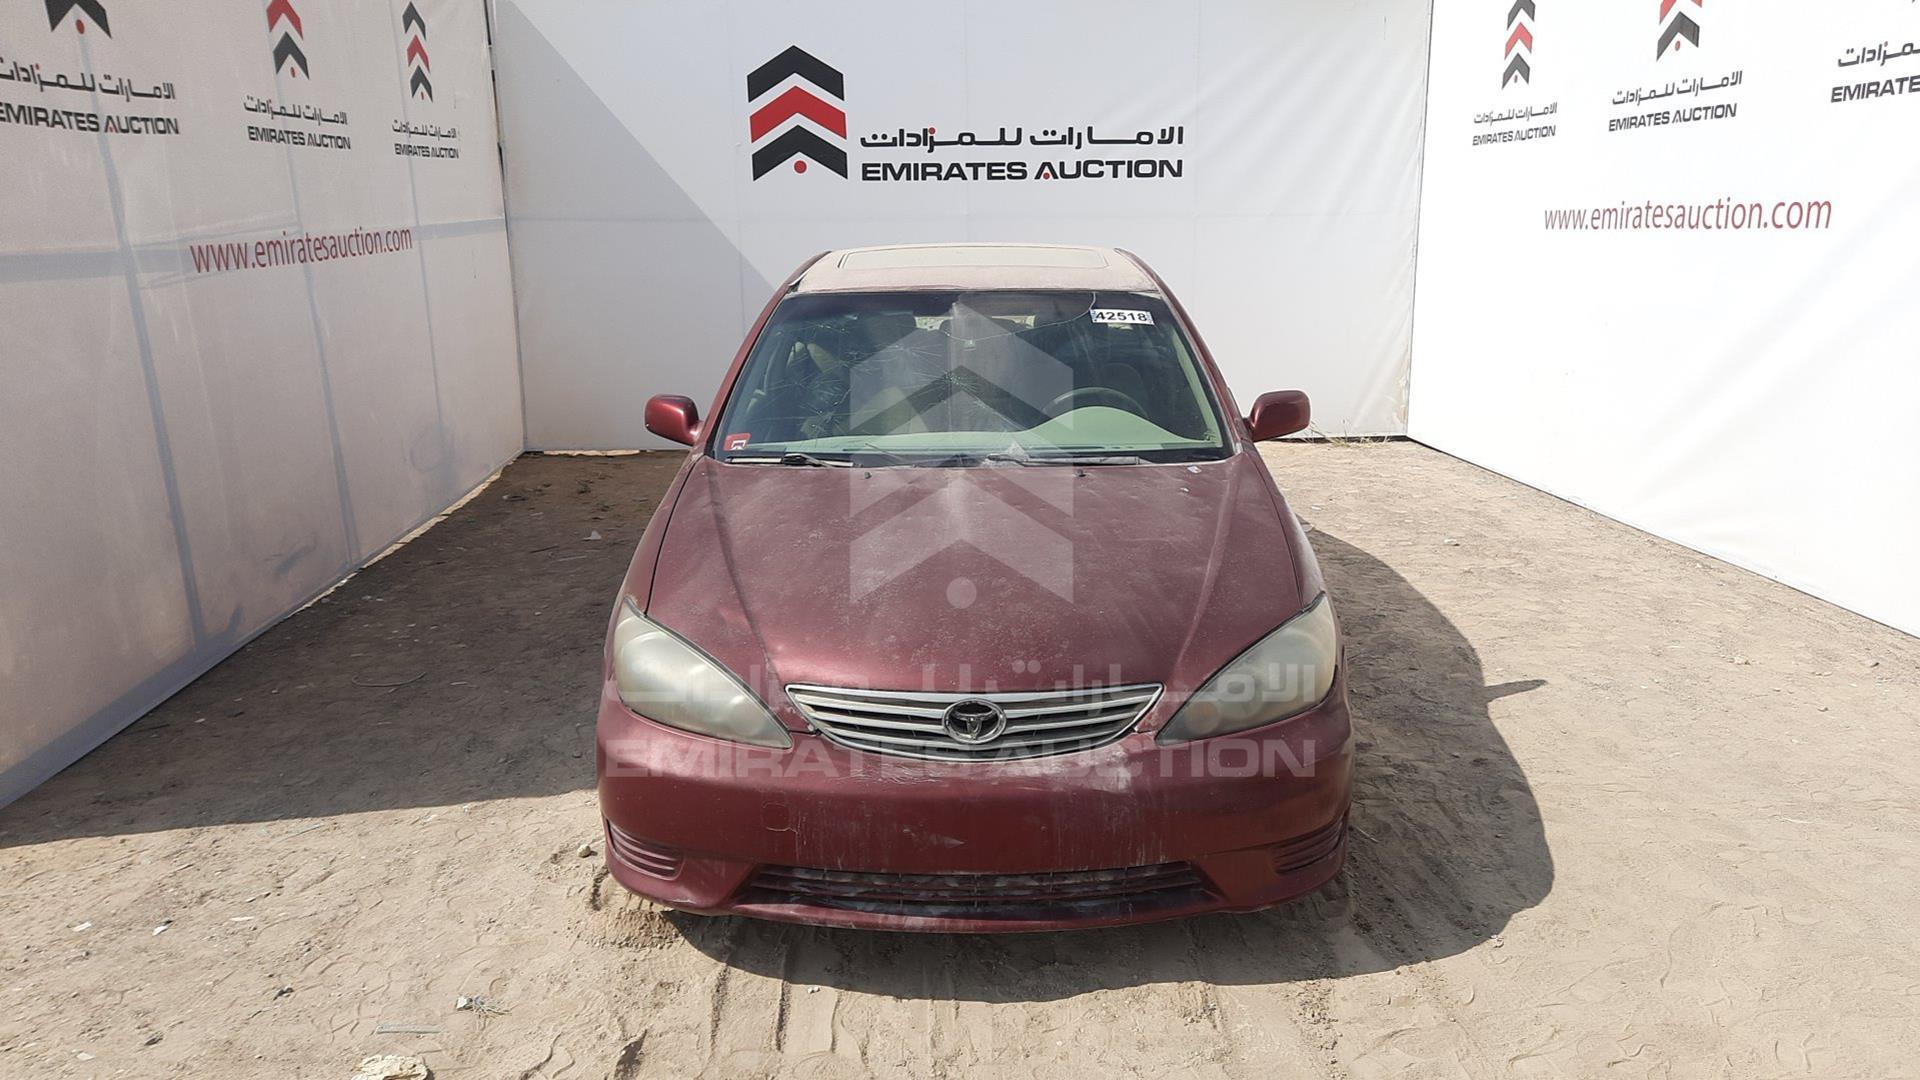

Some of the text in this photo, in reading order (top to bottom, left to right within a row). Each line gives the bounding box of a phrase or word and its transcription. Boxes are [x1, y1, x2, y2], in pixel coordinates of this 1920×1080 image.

[1838, 41, 1920, 67] مزادات
[99, 74, 176, 102] الامارات
[1612, 70, 1743, 106] الامارات للمزادات
[1830, 74, 1920, 103] EMIRATE
[243, 94, 348, 126] الامارات للمزادات
[1608, 102, 1738, 132] EMIRATES AUCTION
[104, 115, 180, 134] AUCTION
[247, 126, 351, 149] EMIRATES AUCTION
[1472, 124, 1556, 146] EMIRATES AUCTION
[394, 143, 459, 159] EMIRATES AUCTION
[860, 126, 1184, 153] الامارات للمزادات
[861, 159, 1183, 181] EMIRATES AUCTION
[1544, 197, 1832, 230] www.emiratesauction.com
[190, 226, 412, 274] www.emiratesauction.com
[1095, 311, 1148, 322] 42518
